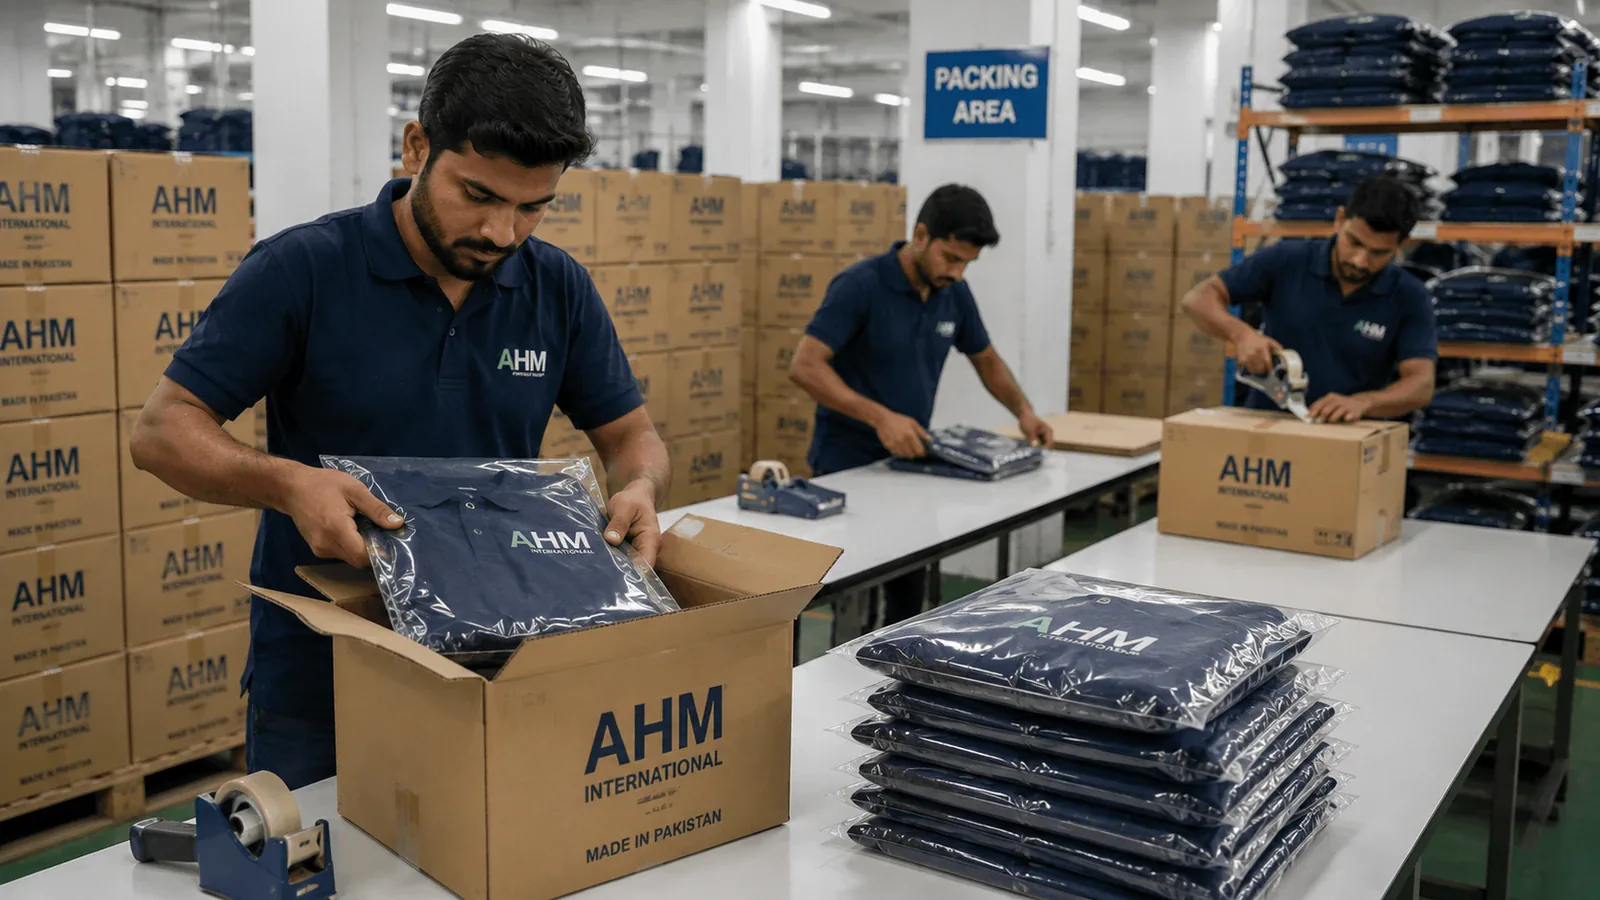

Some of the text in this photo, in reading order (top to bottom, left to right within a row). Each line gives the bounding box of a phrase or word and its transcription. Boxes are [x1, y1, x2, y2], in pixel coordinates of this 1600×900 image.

[934, 63, 1039, 91] PACKING
[952, 99, 1017, 124] AREA
[0, 181, 70, 214] AHM
[152, 185, 217, 215] AHM
[0, 218, 71, 230] TERNATIONAL
[0, 317, 76, 350] AHM
[155, 310, 207, 341] AH
[0, 353, 77, 367] INTERNATIONAL
[497, 348, 547, 372] AHM
[6, 446, 80, 485] AHM
[1218, 454, 1292, 488] AHM
[6, 480, 81, 500] INTERNATIONAL
[1217, 486, 1290, 504] INTERNATIONAL
[511, 530, 591, 549] AHM
[161, 541, 224, 581] AHM
[11, 569, 85, 613] AHM
[11, 604, 85, 627] INTERNATIONAL
[1009, 615, 1160, 653] AHM
[166, 654, 229, 696] AHM
[17, 690, 91, 738] AHM
[584, 684, 723, 776] AHM
[585, 750, 723, 804] INTERNATIONAL
[586, 836, 631, 864] MADE
[635, 831, 650, 849] IN
[654, 808, 722, 842] PAKISTAN
